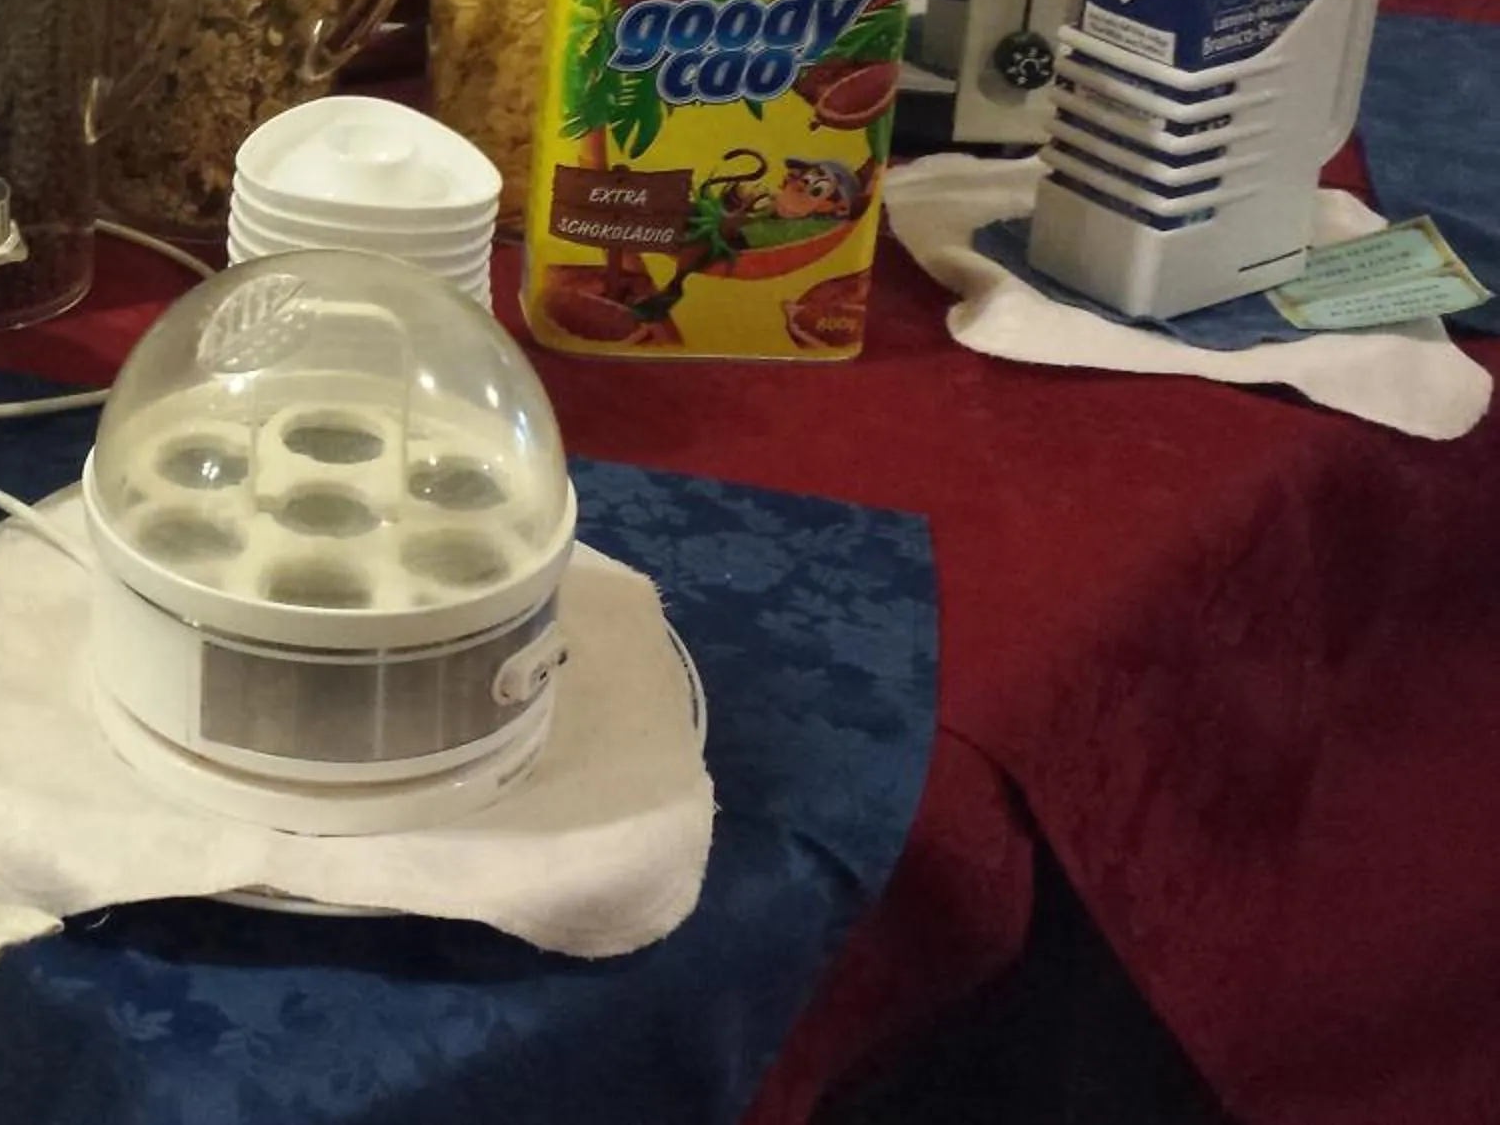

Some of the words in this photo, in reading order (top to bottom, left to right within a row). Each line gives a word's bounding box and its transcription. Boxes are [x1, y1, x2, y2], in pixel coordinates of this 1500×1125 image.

[656, 48, 800, 105] cao
[589, 188, 648, 206] EXTRA
[557, 217, 675, 244] SCHOKOLADIG
